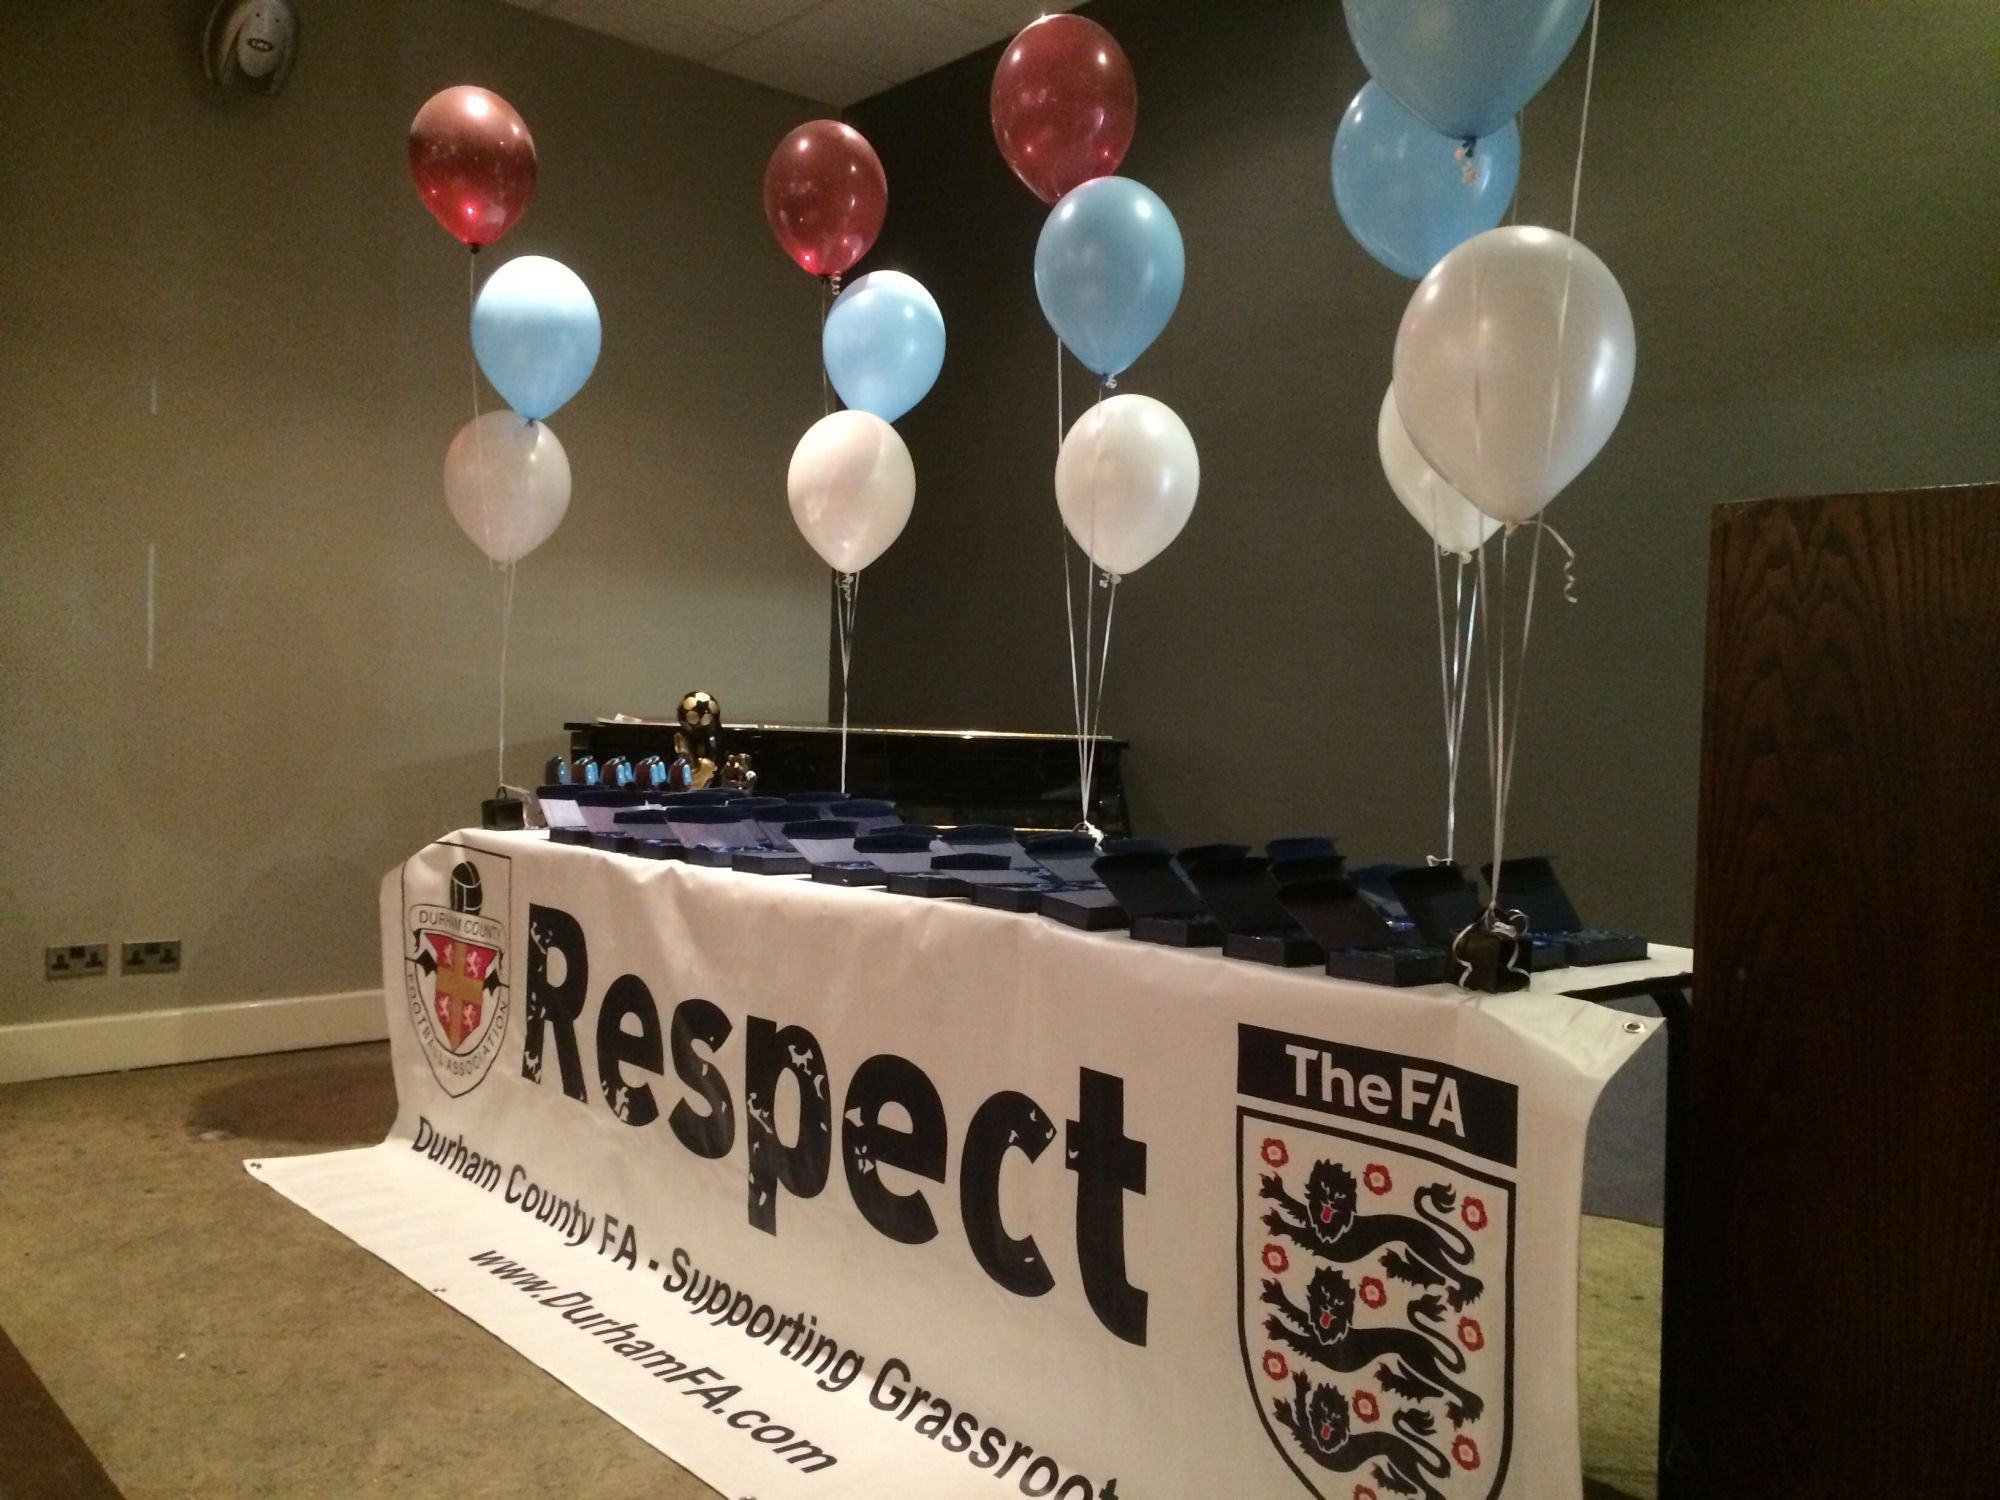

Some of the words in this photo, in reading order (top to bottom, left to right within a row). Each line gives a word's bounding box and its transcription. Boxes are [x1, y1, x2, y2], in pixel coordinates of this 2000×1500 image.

[520, 902, 1149, 1347] Respect
[1285, 1043, 1393, 1116] The
[1400, 1066, 1466, 1138] FA
[411, 1115, 501, 1193] Durham
[503, 1163, 595, 1247] County
[597, 1213, 638, 1271] FA
[662, 1247, 866, 1393] Supporting
[468, 1249, 838, 1474] www.DurhamFA.com
